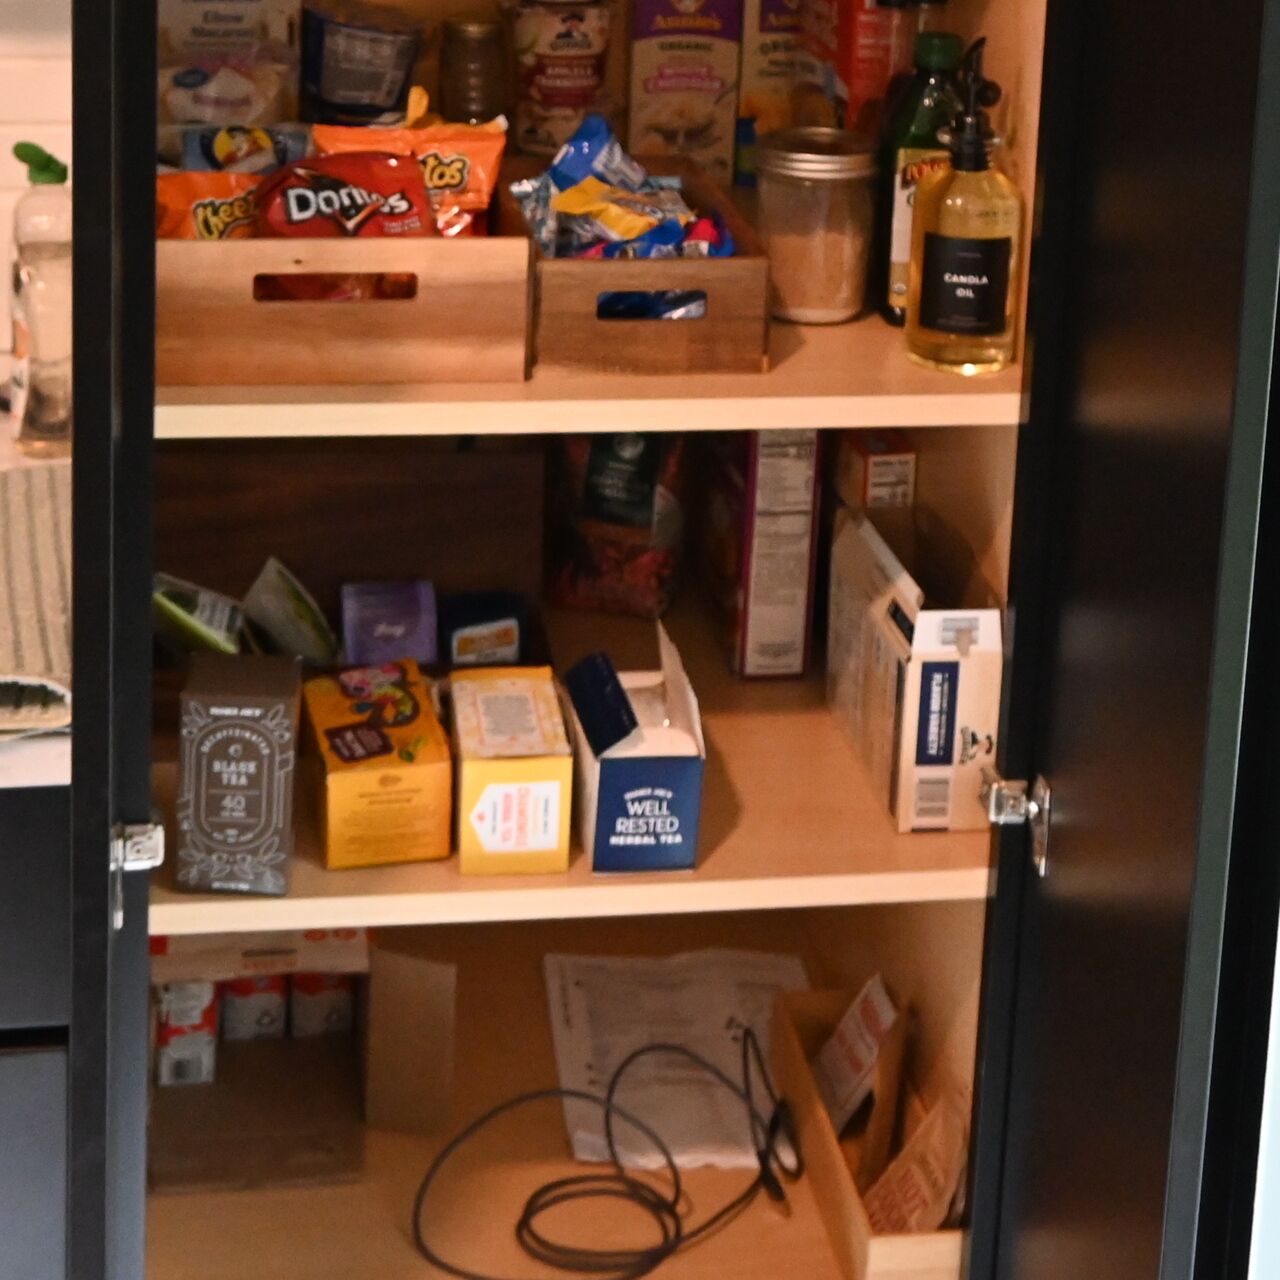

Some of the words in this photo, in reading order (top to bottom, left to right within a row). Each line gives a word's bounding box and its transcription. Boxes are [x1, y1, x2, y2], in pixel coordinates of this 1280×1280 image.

[287, 185, 411, 223] Doritos
[194, 190, 257, 240] Chee
[943, 272, 989, 285] CANOLA
[955, 288, 975, 299] OIL
[212, 760, 257, 775] BLACK
[221, 774, 248, 787] TEA
[626, 800, 670, 816] WELL
[615, 816, 680, 834] RESTED
[609, 834, 657, 846] HERBAL
[660, 833, 683, 845] TEA
